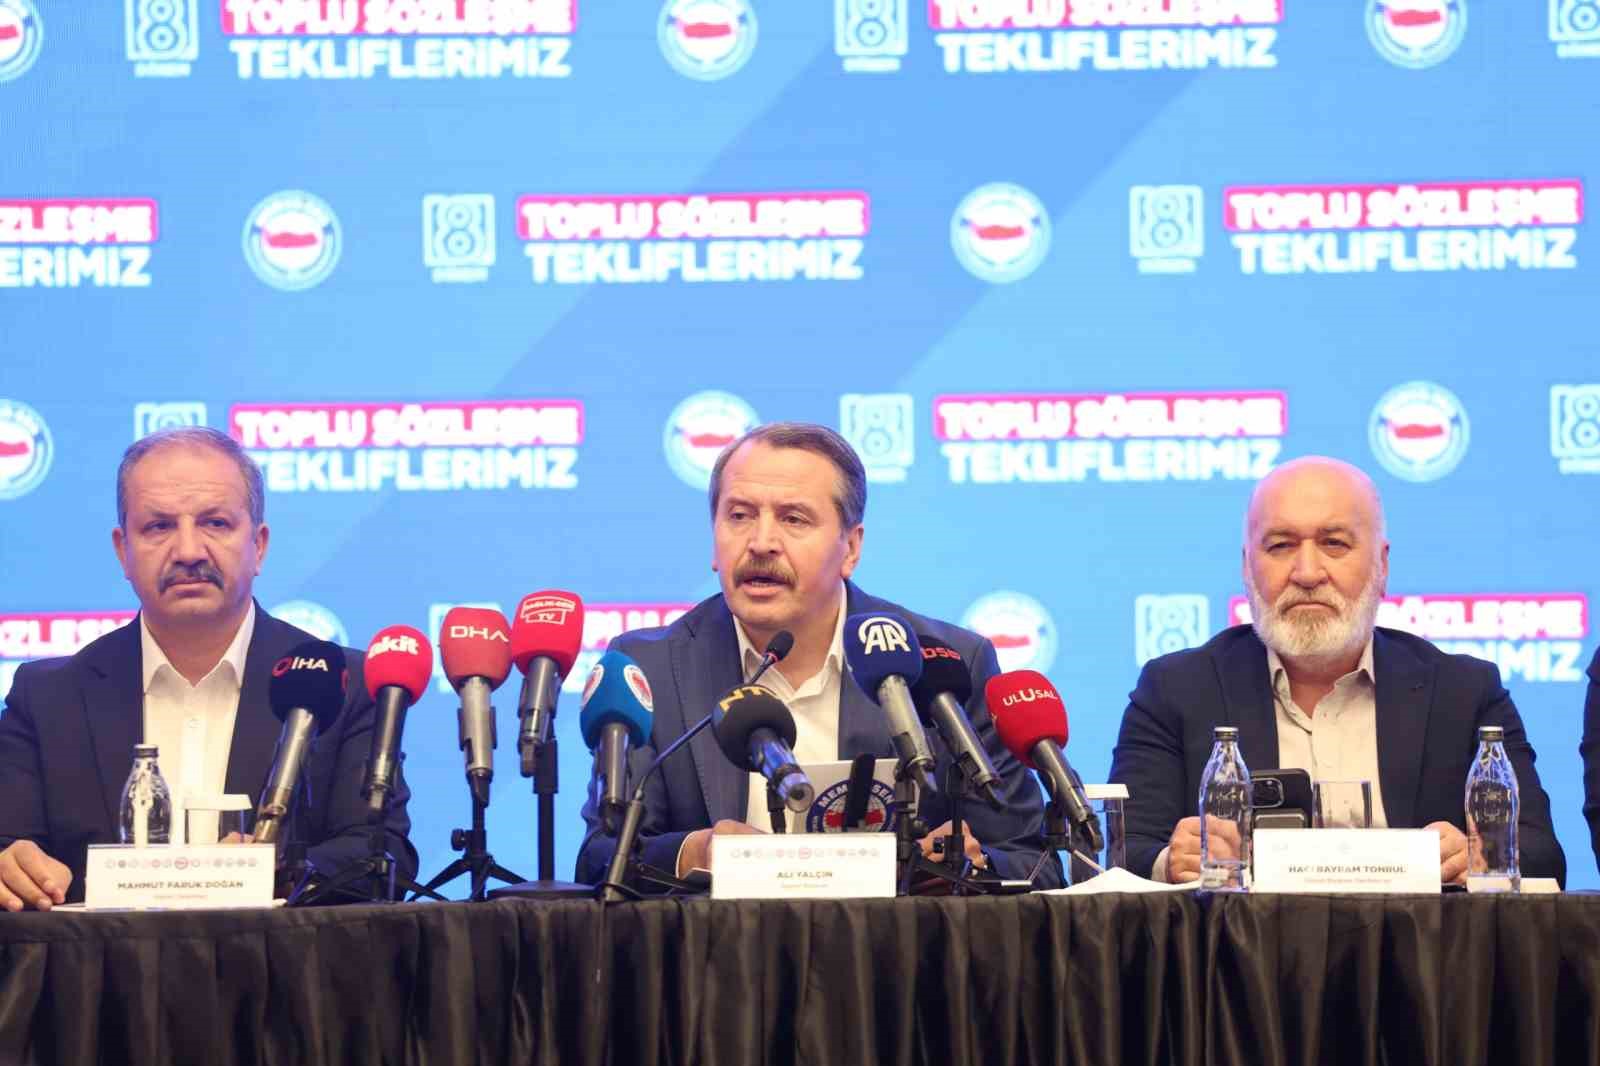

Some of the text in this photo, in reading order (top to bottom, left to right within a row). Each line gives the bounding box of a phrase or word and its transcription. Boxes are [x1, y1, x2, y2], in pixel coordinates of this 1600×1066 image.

[224, 0, 359, 35] TOPLU
[521, 202, 655, 239] TOPLU
[1229, 191, 1363, 230] TOPLU
[234, 409, 368, 448] TOPLU
[938, 400, 1072, 440] TOPLU
[864, 623, 911, 655] AA
[1003, 687, 1058, 706] ULUSAL
